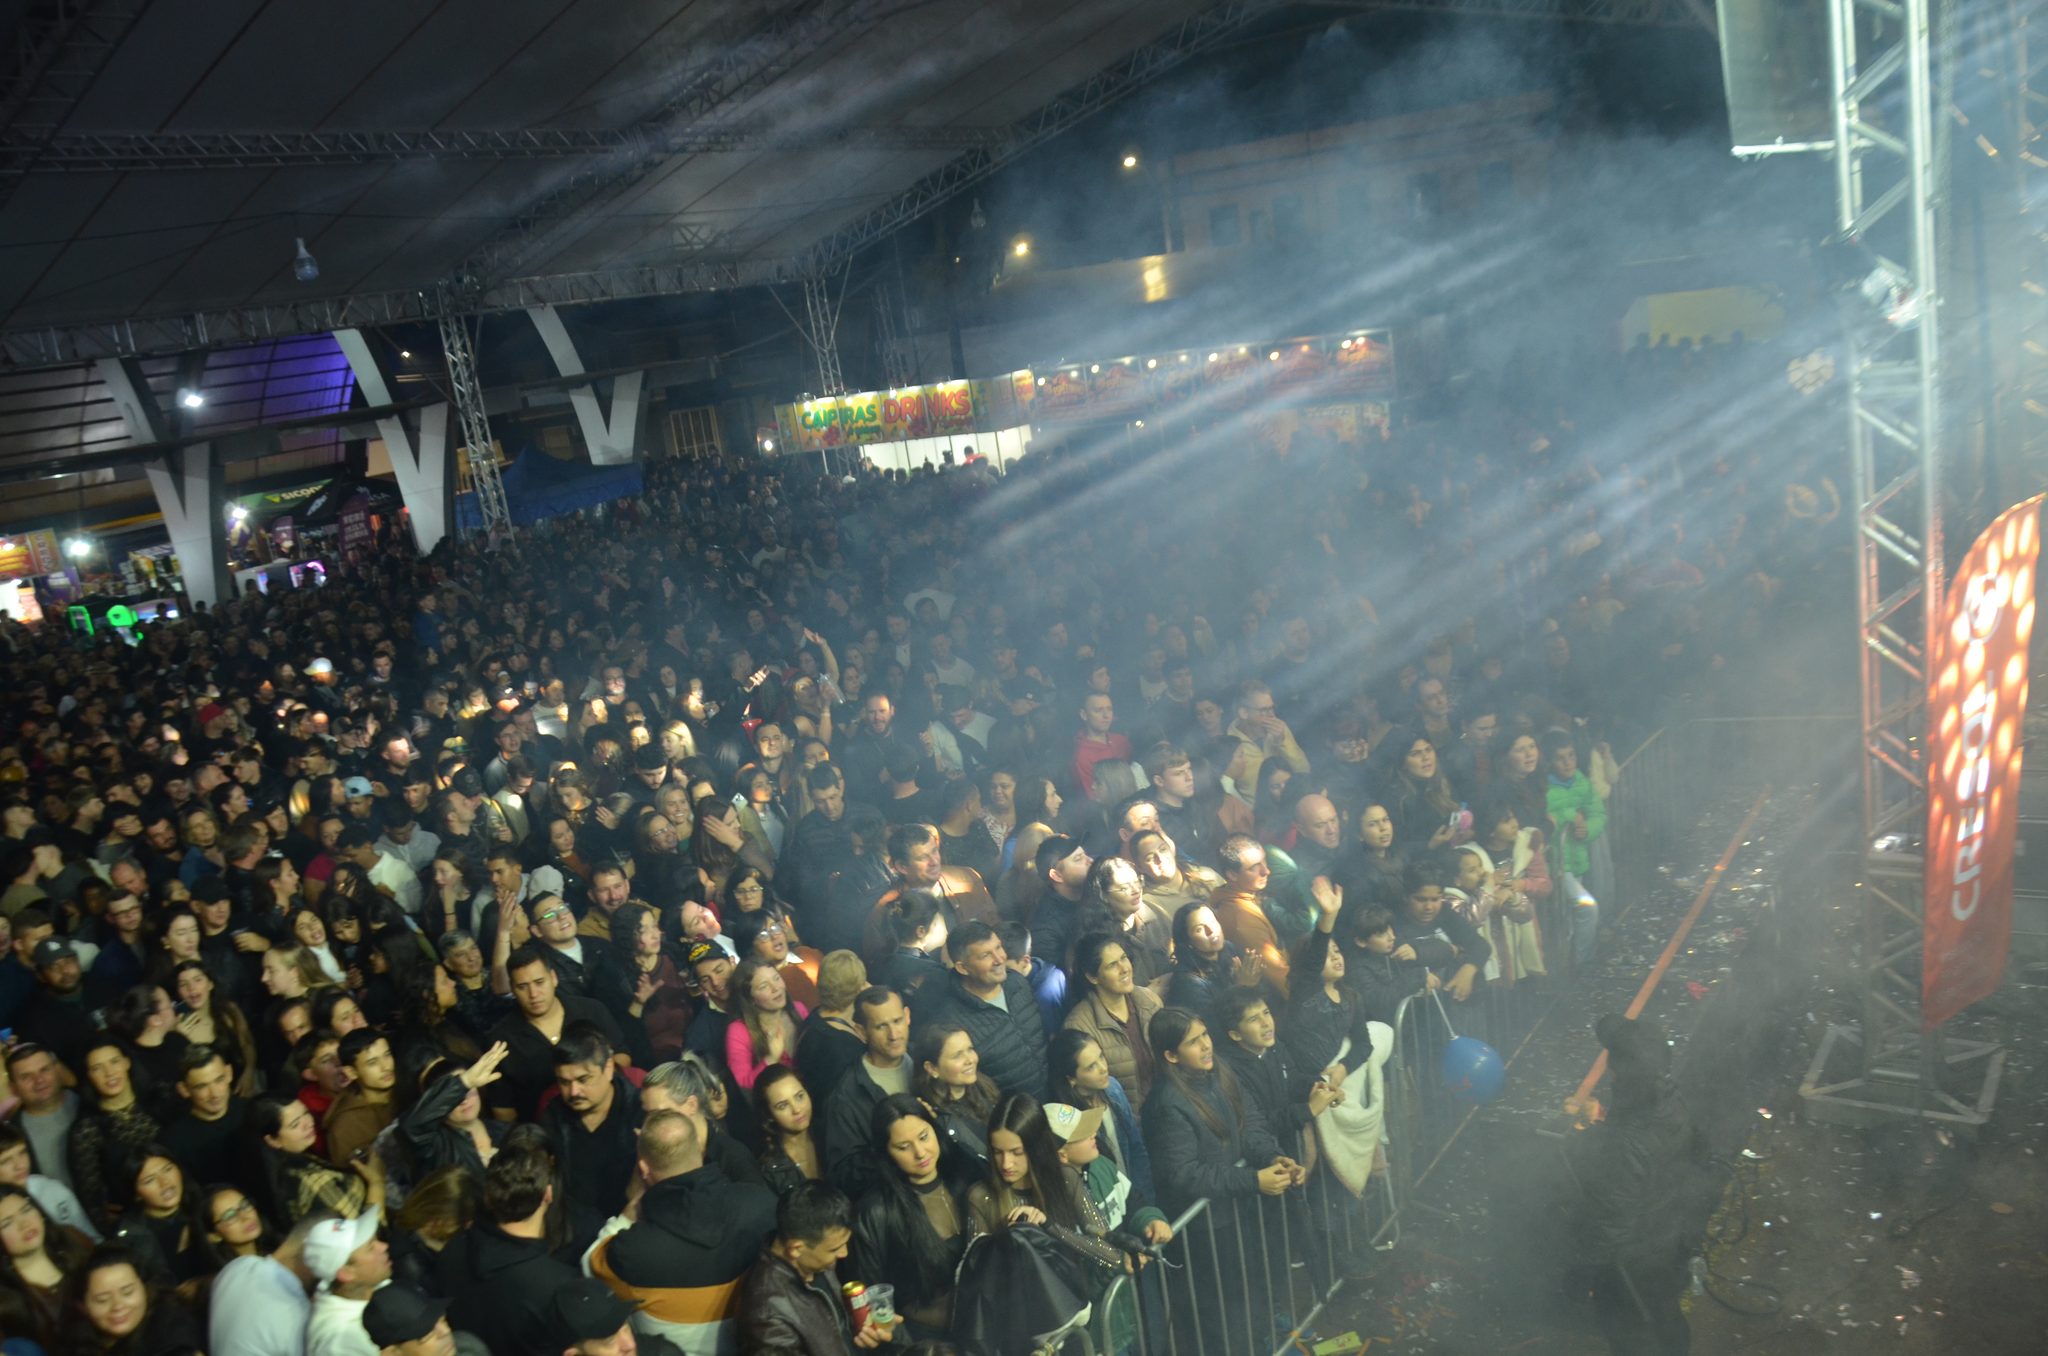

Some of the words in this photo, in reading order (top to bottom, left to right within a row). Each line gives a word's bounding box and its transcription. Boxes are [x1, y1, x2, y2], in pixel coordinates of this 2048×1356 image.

[801, 403, 877, 430] CAIPIRAS
[883, 389, 971, 423] DRINKS
[1952, 669, 1995, 921] CRESOL
